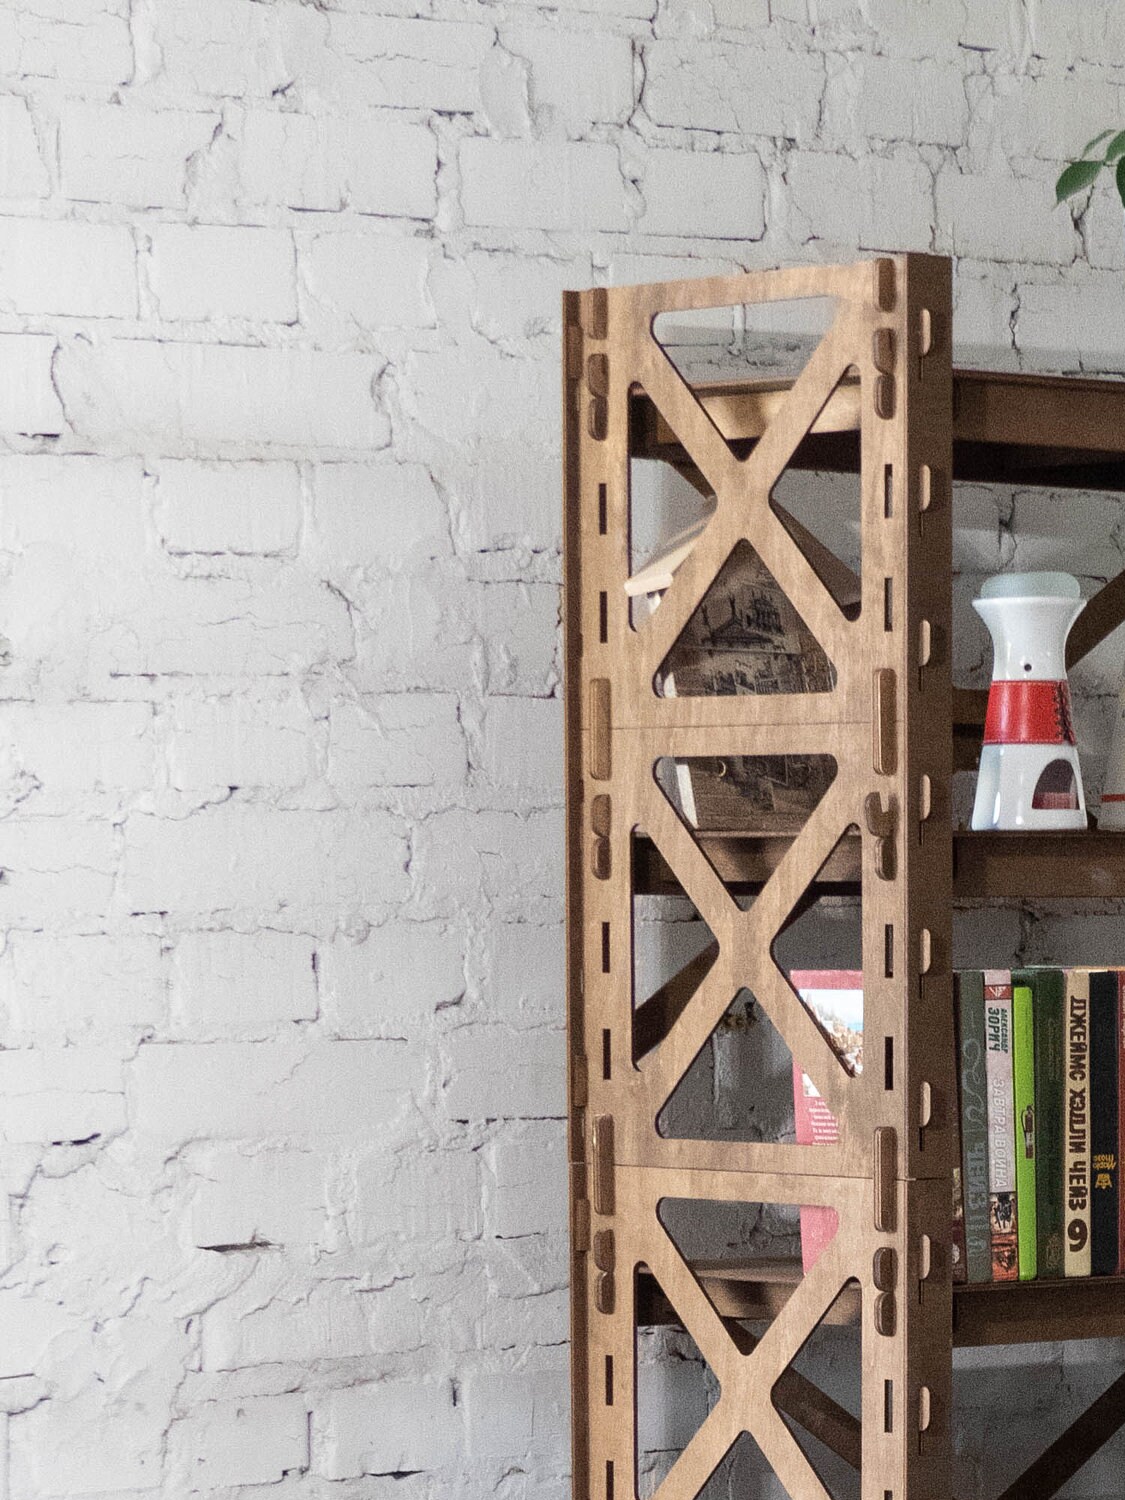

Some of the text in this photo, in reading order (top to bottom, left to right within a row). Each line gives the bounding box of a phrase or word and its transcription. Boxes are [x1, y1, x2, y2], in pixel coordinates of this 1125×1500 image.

[988, 1007, 1000, 1052] ЗОРИЧ
[992, 1077, 1009, 1188] ЗАВТРА ВОЙНА
[1068, 995, 1088, 1211] ДЖЕЙМС ХЭДЛИ ЧЕЙЗ
[1067, 1218, 1088, 1253] 9
